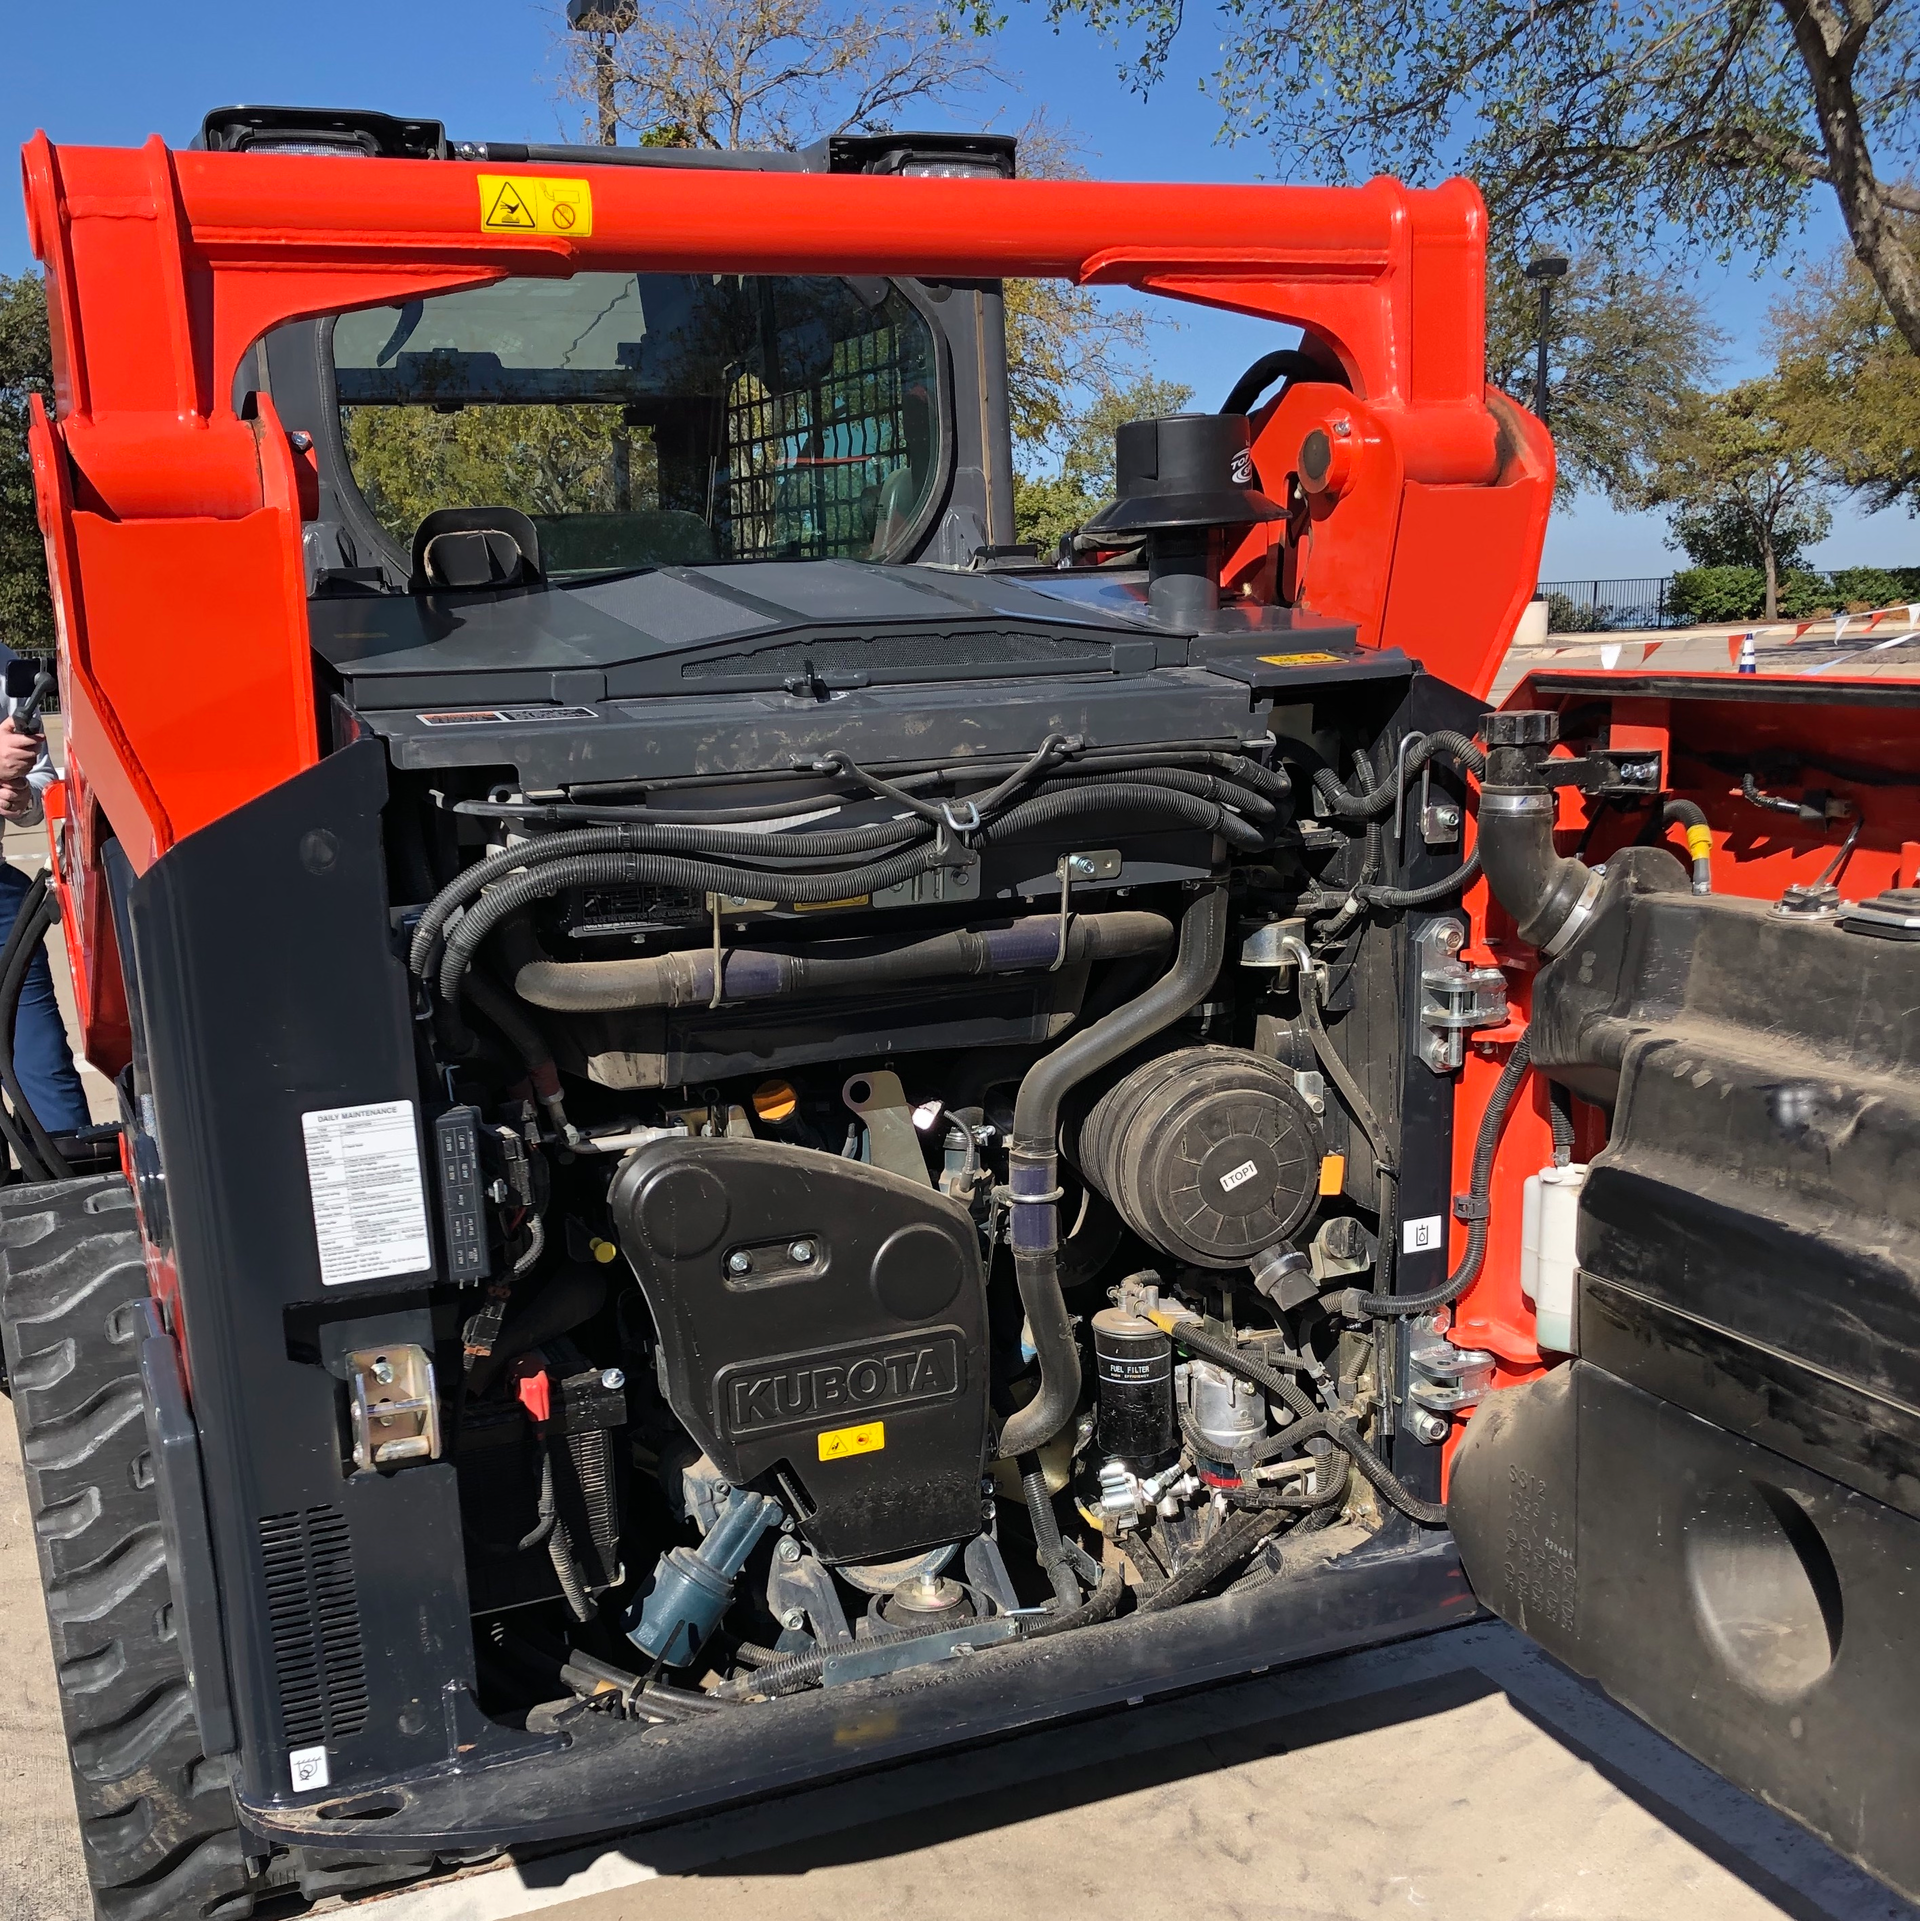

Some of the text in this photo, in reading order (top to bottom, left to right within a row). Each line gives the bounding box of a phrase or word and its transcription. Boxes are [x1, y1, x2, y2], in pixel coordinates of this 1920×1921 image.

[317, 1106, 397, 1123] DAILY MAINTENANCE
[1228, 1167, 1249, 1184] TOP
[1110, 1364, 1150, 1374] FUEL FILTER
[735, 1348, 949, 1424] KUBOTA
